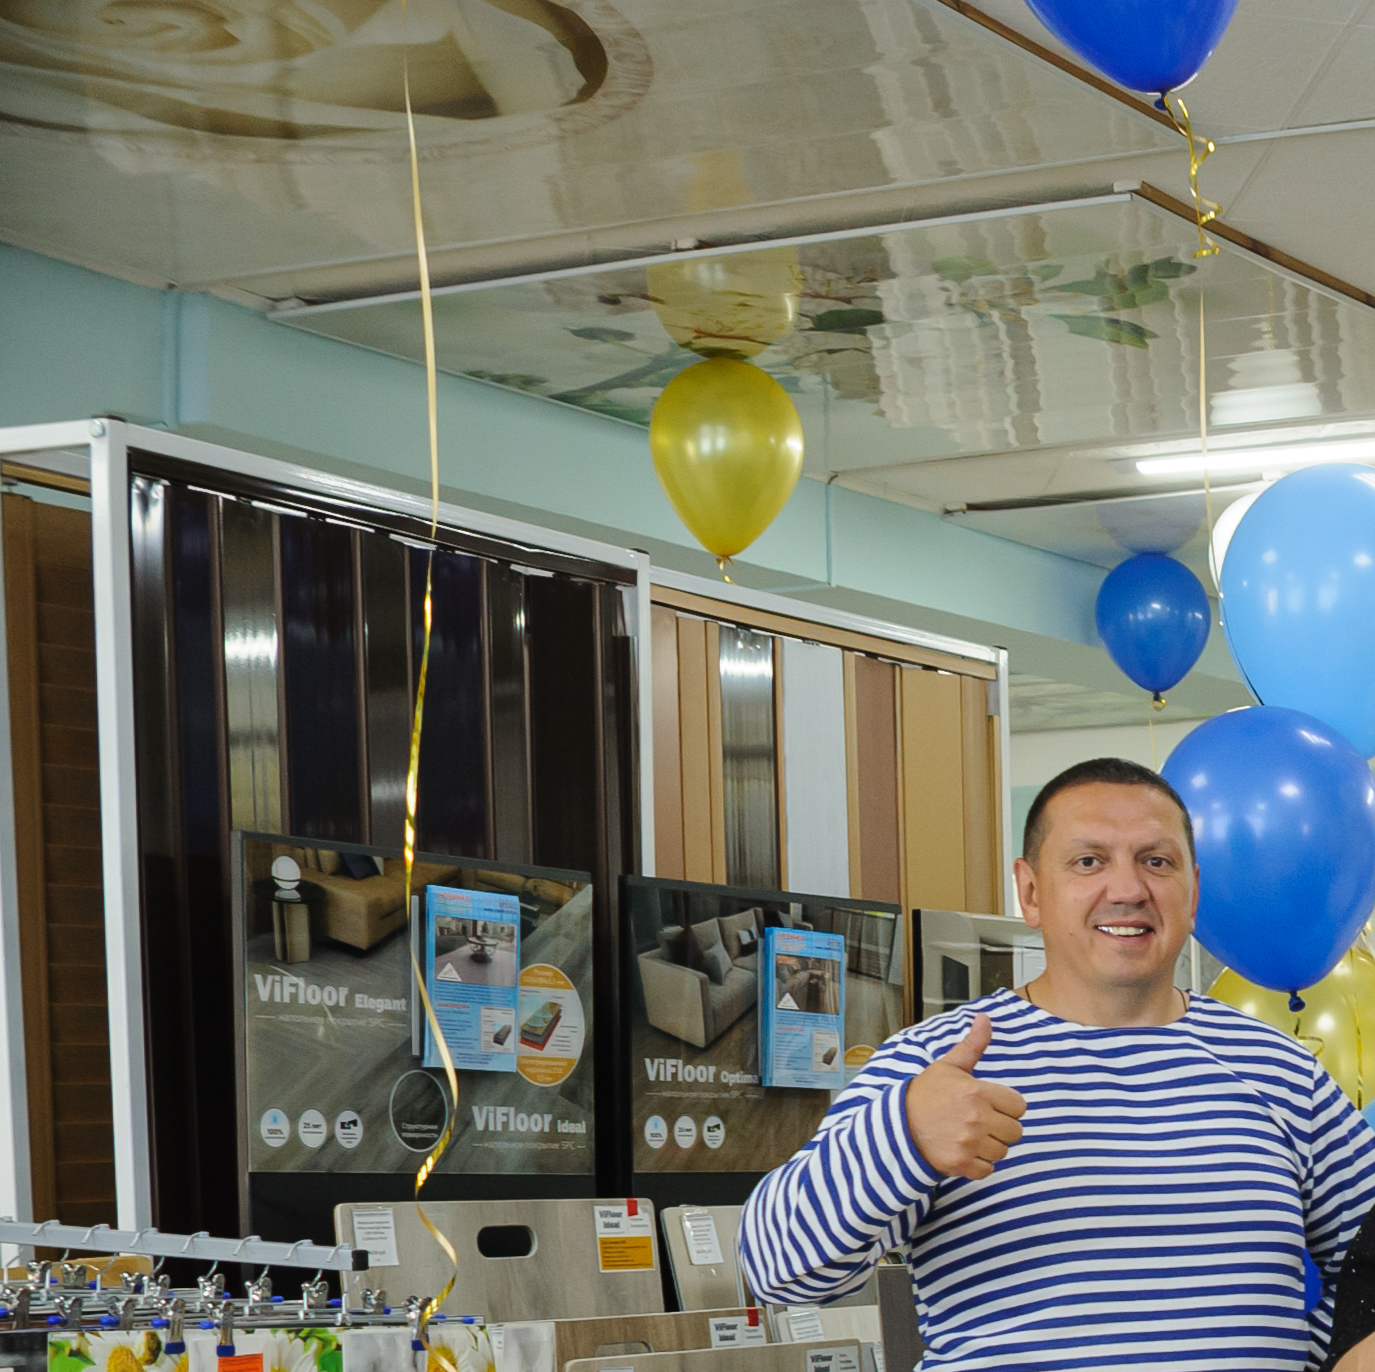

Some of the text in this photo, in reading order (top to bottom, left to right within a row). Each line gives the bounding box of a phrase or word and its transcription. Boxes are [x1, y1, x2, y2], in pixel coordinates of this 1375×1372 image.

[253, 973, 350, 1008] ViFloor
[354, 993, 408, 1013] Elegant
[643, 1057, 760, 1087] ViFloor Optima
[471, 1105, 587, 1135] ViFloor Ideal
[713, 1322, 739, 1332] ViFloor
[718, 1334, 736, 1342] Ideal
[810, 1353, 834, 1364] ViFloor
